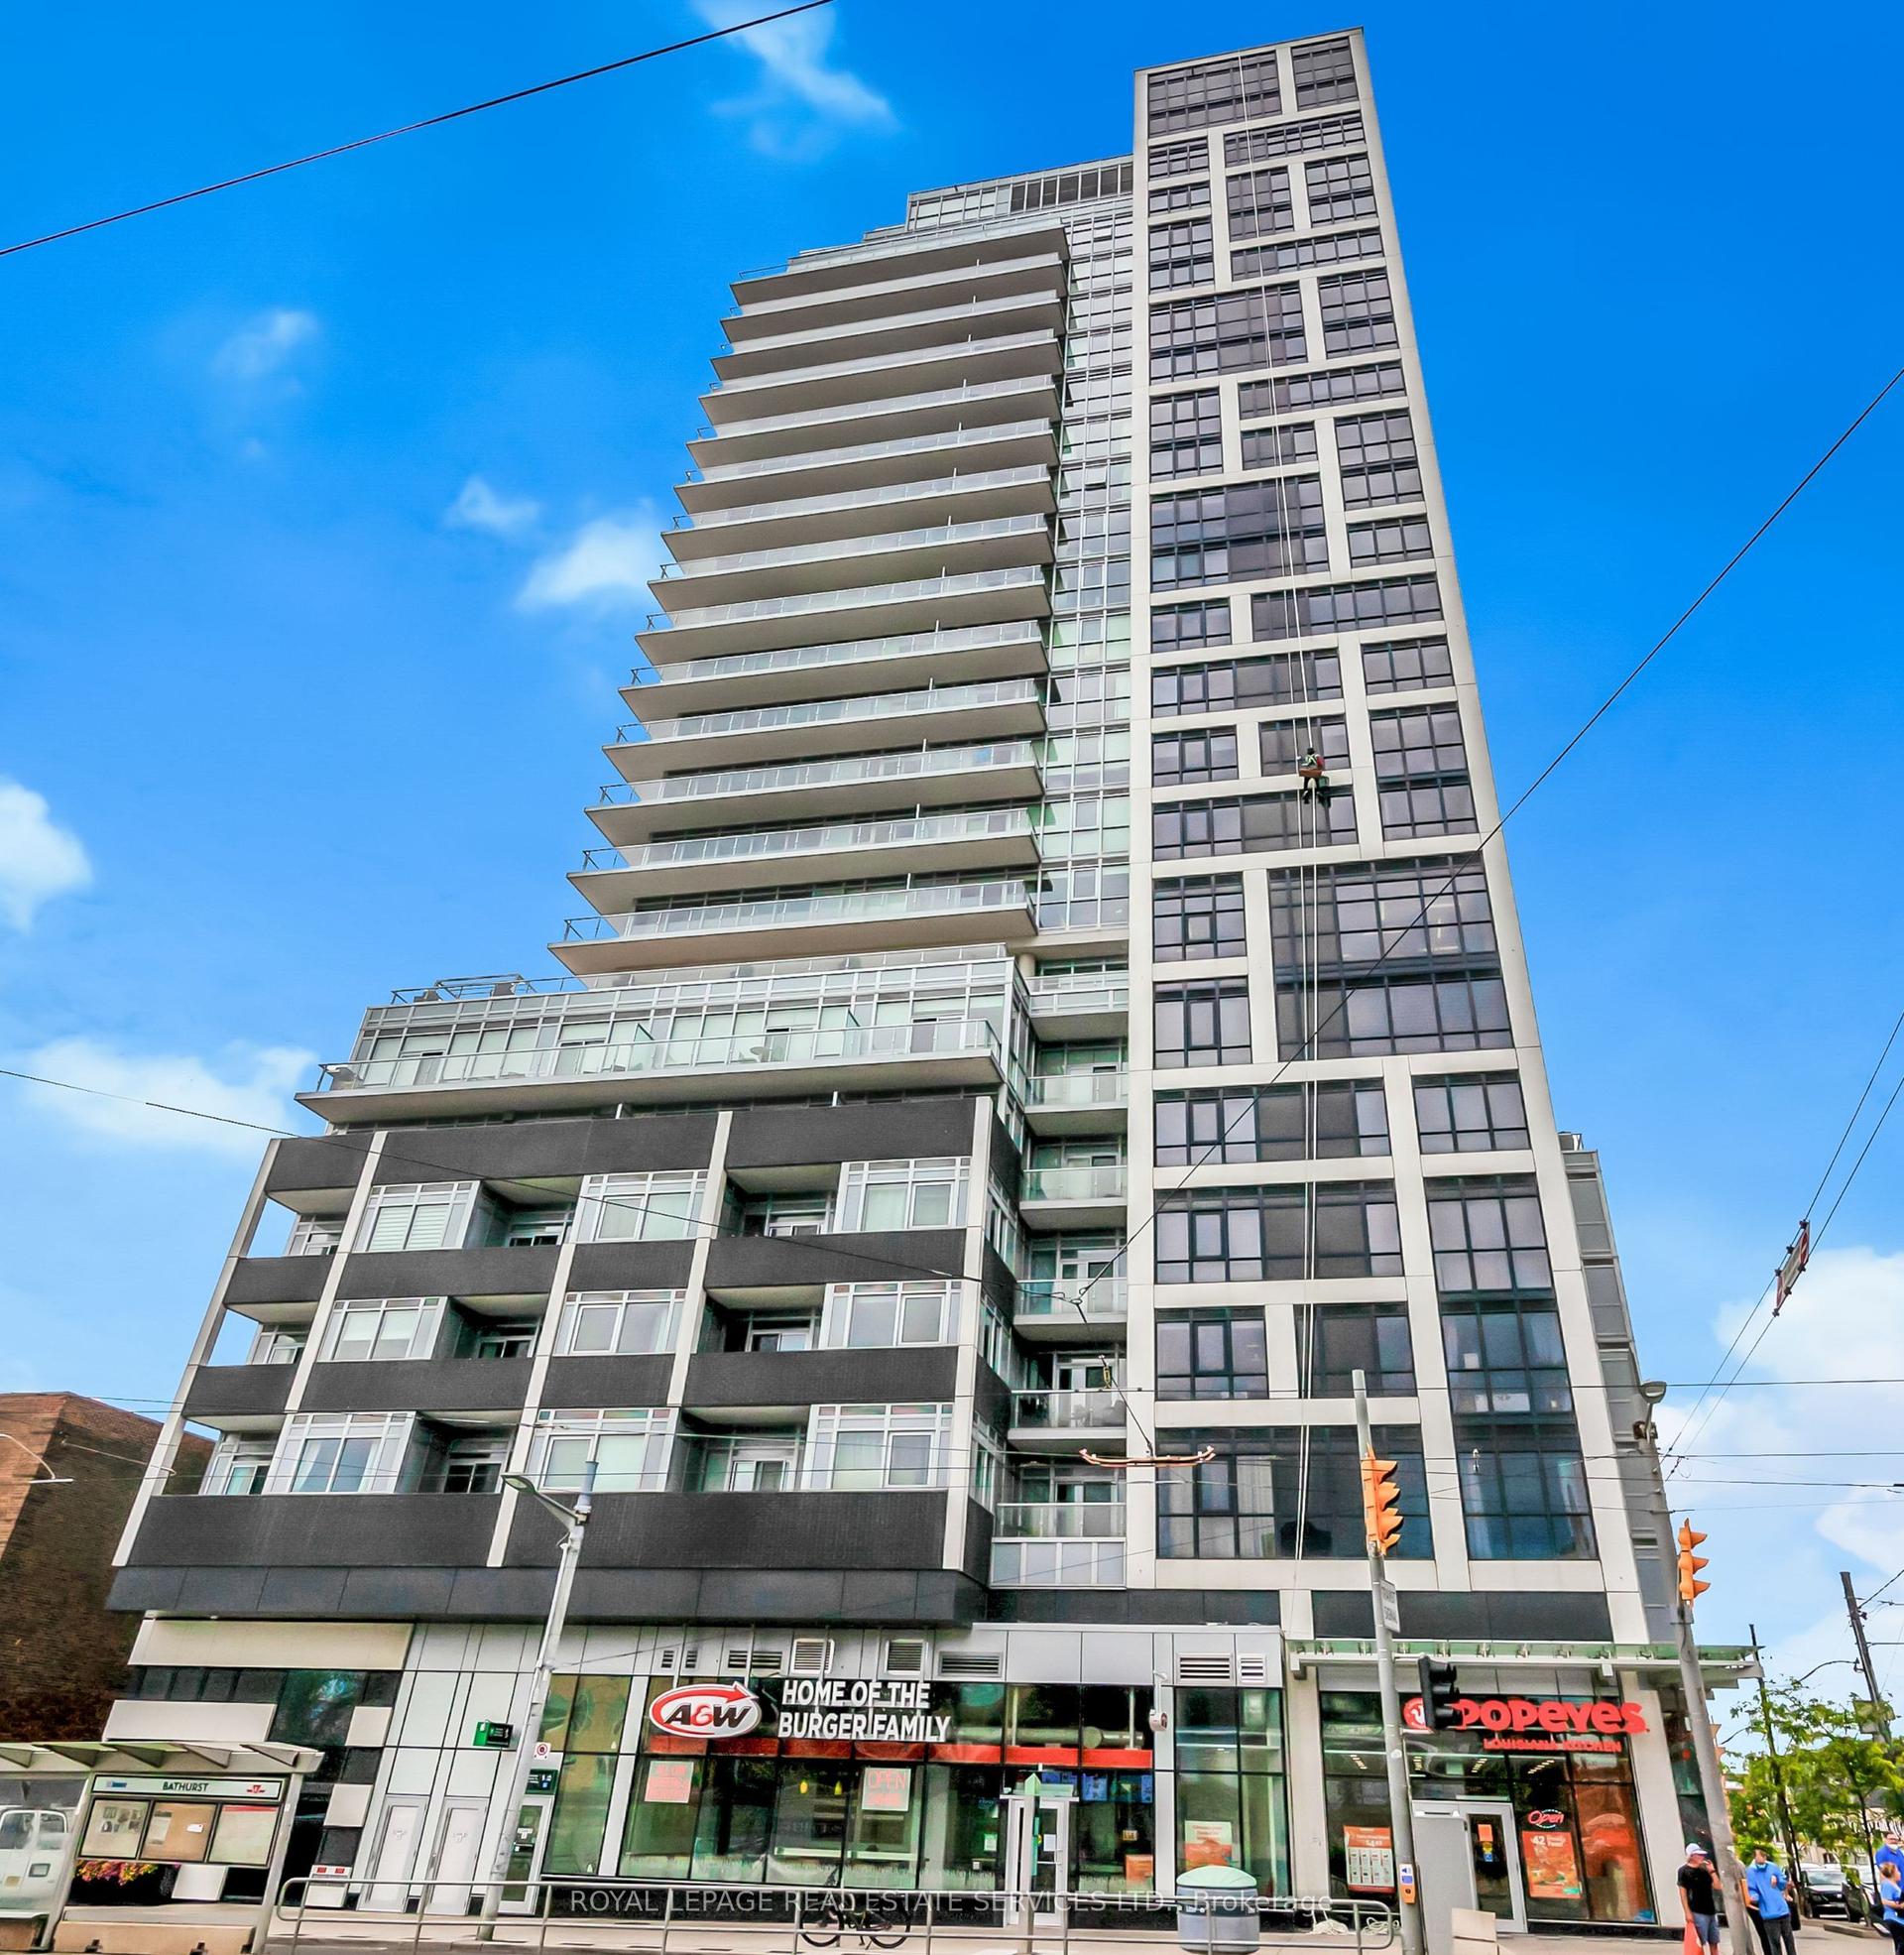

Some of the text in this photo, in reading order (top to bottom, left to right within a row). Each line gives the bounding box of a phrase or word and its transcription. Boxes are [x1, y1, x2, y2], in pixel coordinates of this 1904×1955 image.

[782, 1679, 931, 1709] HOME OF THE
[663, 1702, 753, 1729] A&W
[777, 1712, 952, 1743] BURGER FAMILY
[162, 1781, 209, 1792] BATHURST
[1527, 1810, 1565, 1825] Open
